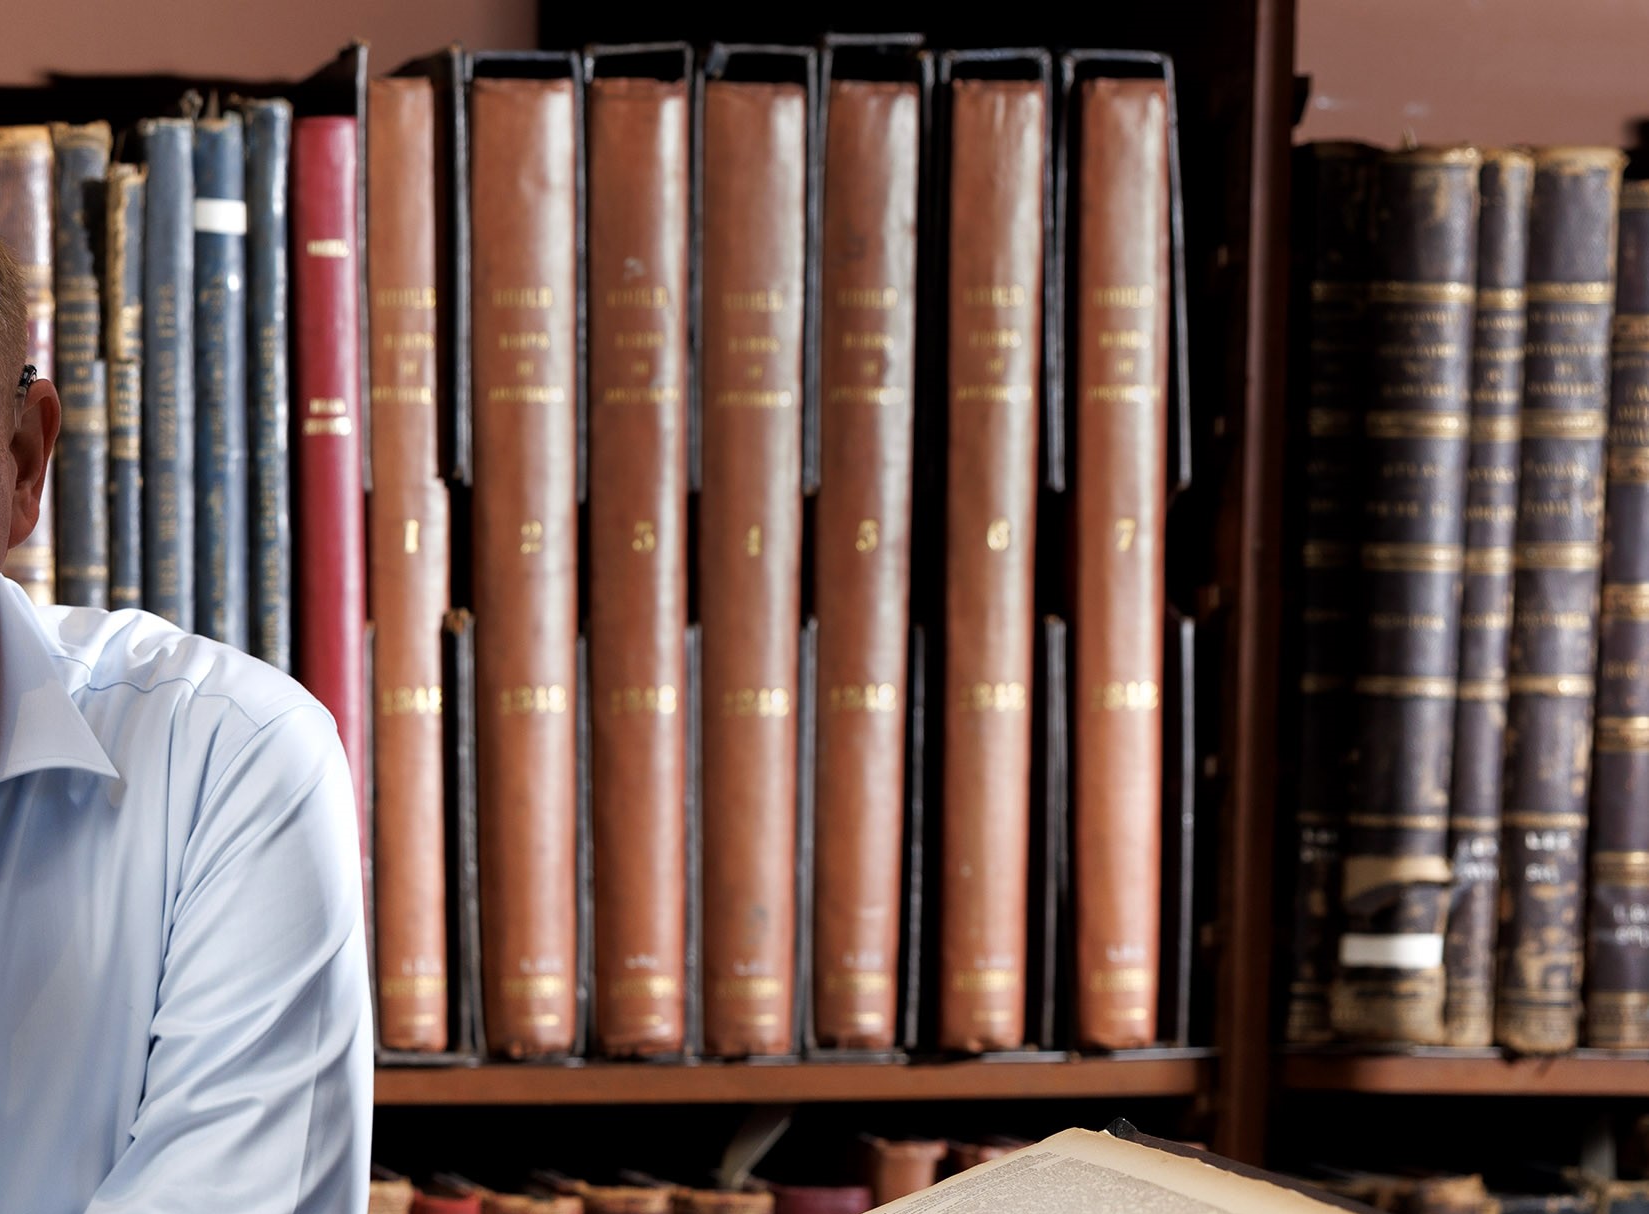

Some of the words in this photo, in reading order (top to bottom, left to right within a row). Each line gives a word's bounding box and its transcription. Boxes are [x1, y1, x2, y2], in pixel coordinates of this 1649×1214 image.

[403, 518, 419, 555] 1
[520, 519, 542, 555] 2
[631, 519, 656, 553] 3
[855, 517, 879, 553] 5
[986, 517, 1011, 553] 6
[1115, 517, 1136, 553] 7
